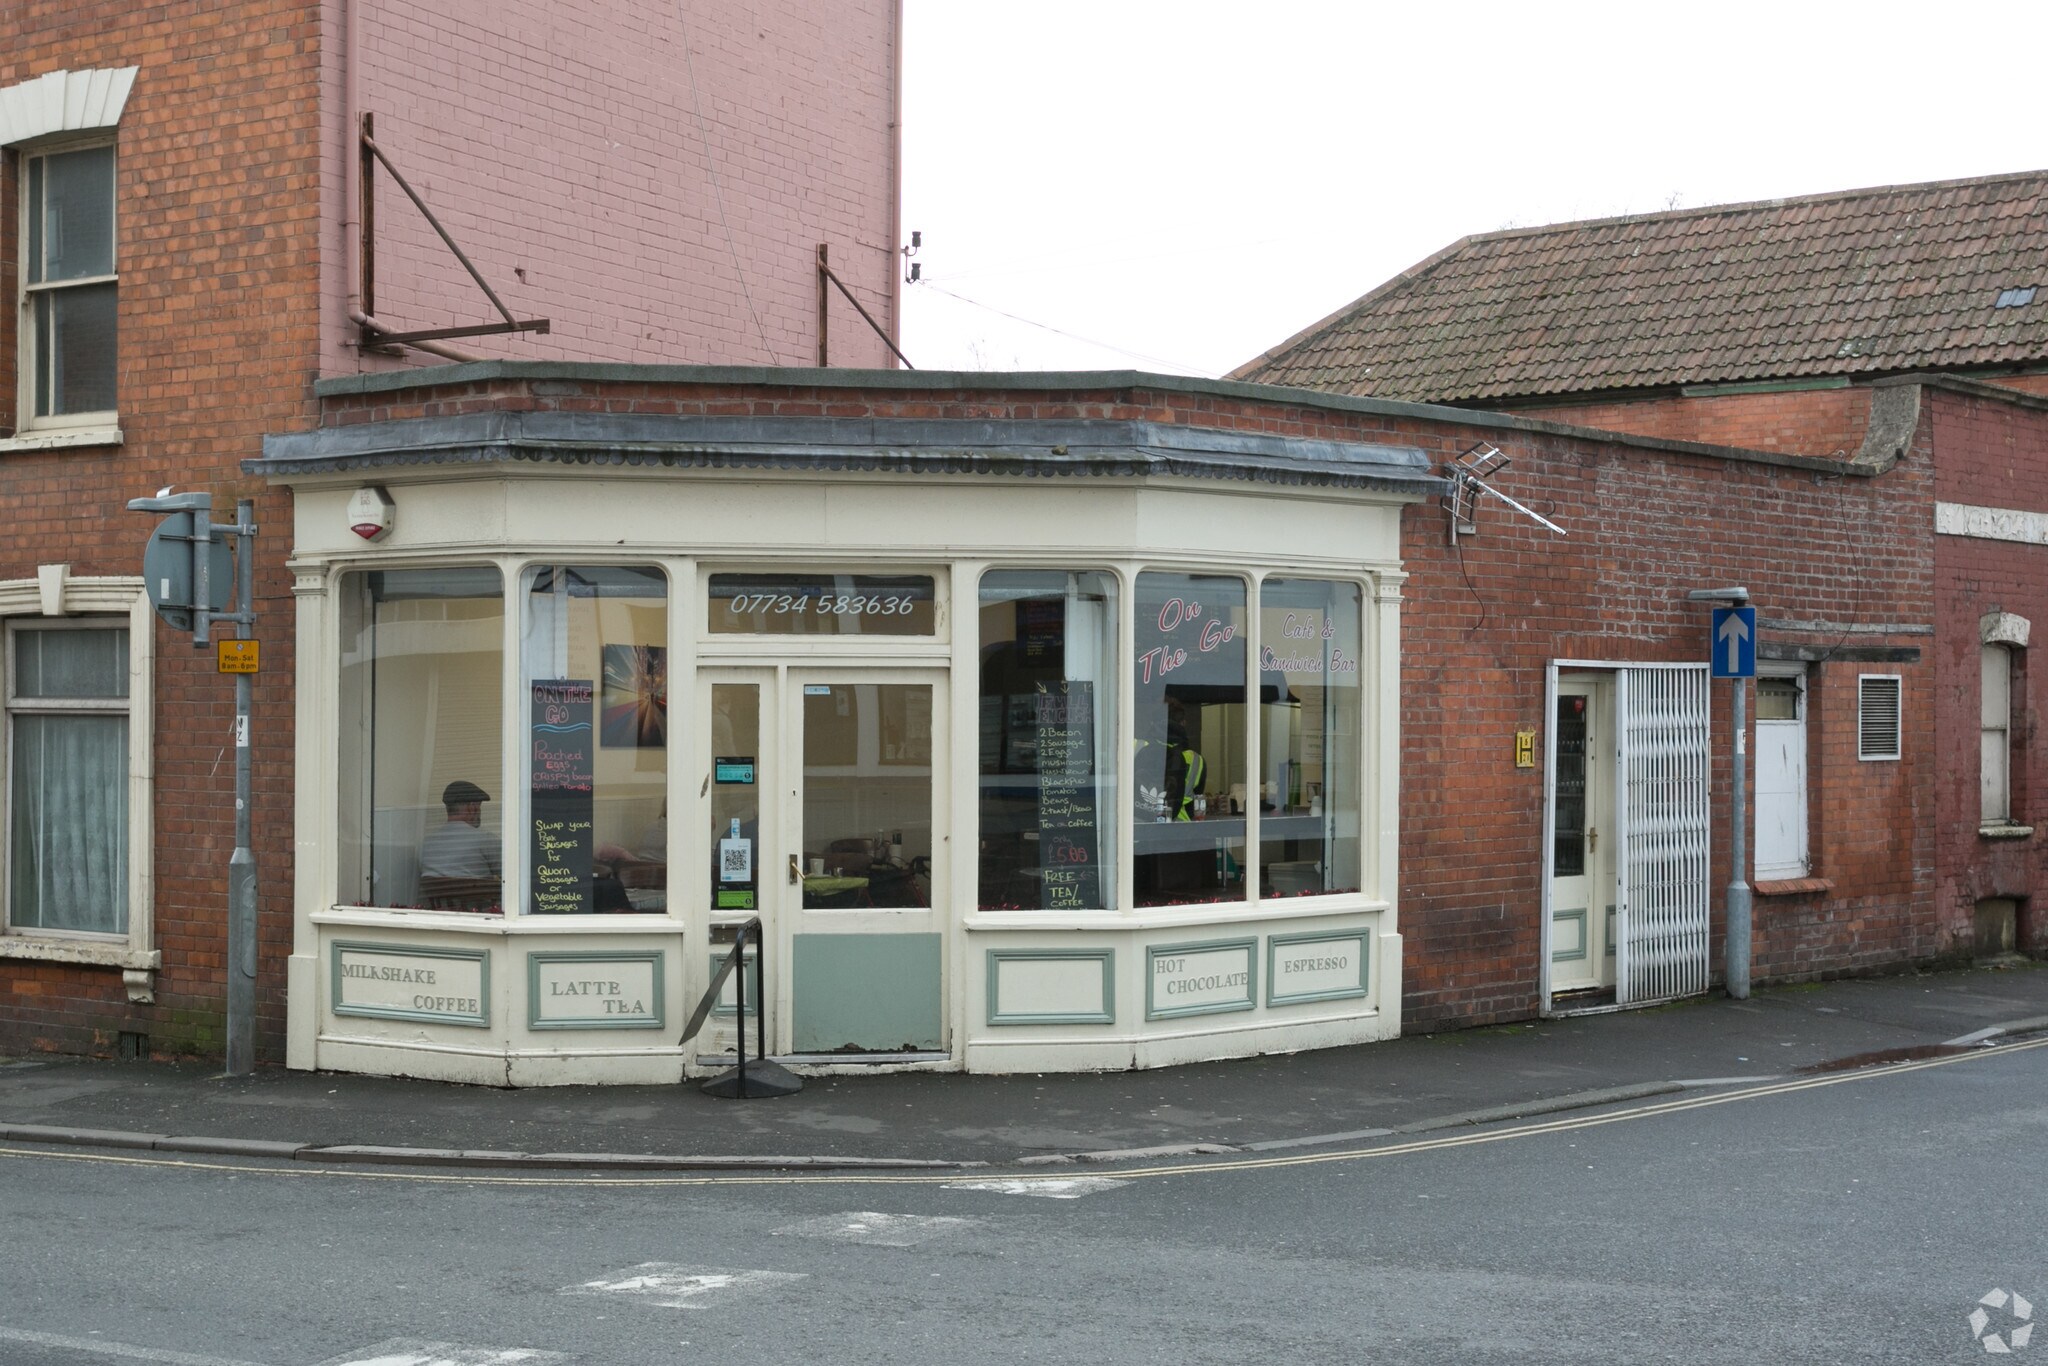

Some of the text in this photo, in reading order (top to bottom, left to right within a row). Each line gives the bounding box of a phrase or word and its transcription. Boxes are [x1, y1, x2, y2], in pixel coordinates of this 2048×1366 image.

[730, 594, 914, 615] 07734 583636
[1158, 597, 1202, 632] On
[1282, 612, 1335, 640] Cafe &
[1138, 619, 1238, 684] The Go
[1259, 645, 1357, 672] Sandwich Bar
[545, 704, 570, 724] GO
[537, 865, 571, 876] Quorn
[535, 892, 584, 903] Vegetable
[341, 963, 436, 985] MILKSHAKE
[1156, 958, 1185, 974] HOT
[1284, 956, 1348, 973] ESPRESSO
[551, 981, 621, 996] LATTE
[1166, 971, 1249, 995] CHOCOLATE
[413, 995, 477, 1013] COFFEE
[602, 999, 646, 1014] TEA
